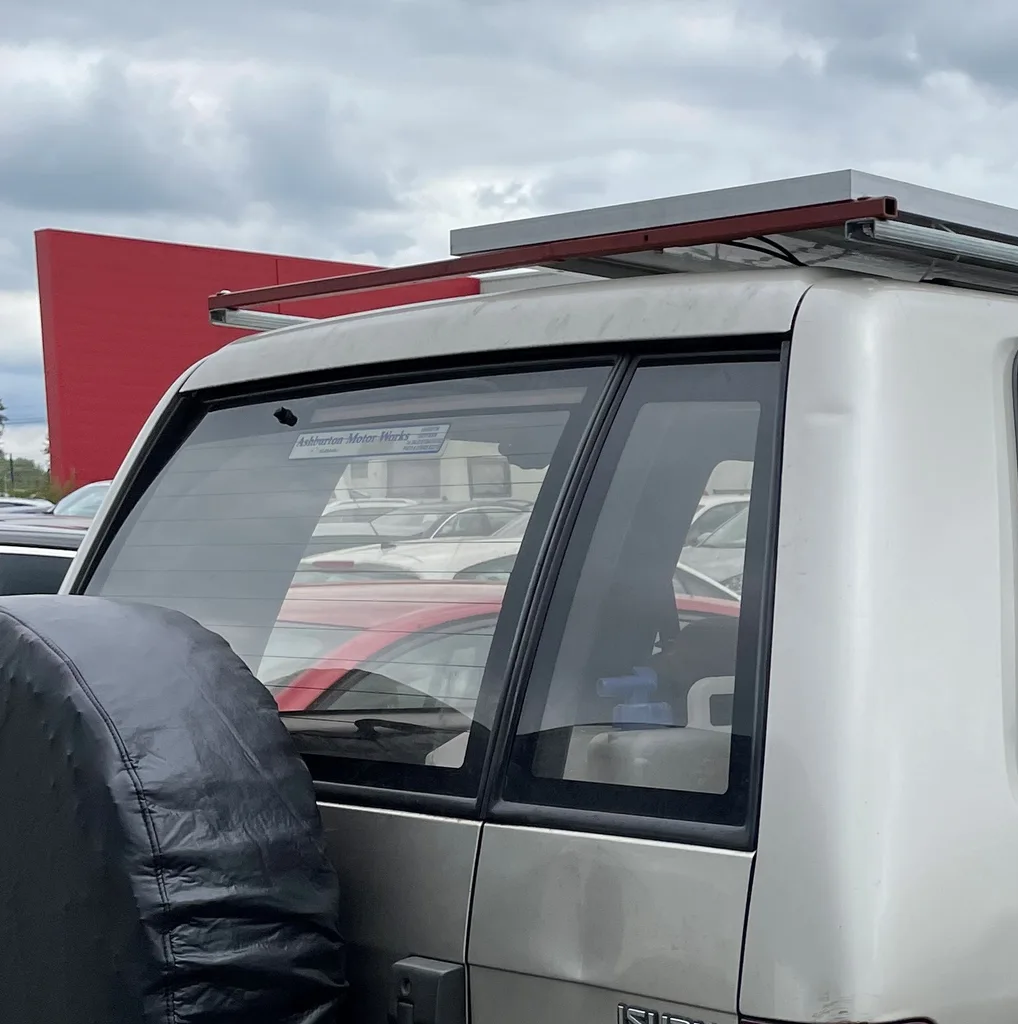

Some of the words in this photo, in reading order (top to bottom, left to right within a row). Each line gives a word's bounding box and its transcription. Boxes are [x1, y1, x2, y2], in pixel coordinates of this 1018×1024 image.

[295, 435, 343, 447] Ashburton
[346, 432, 378, 444] Motor
[379, 430, 410, 442] Works
